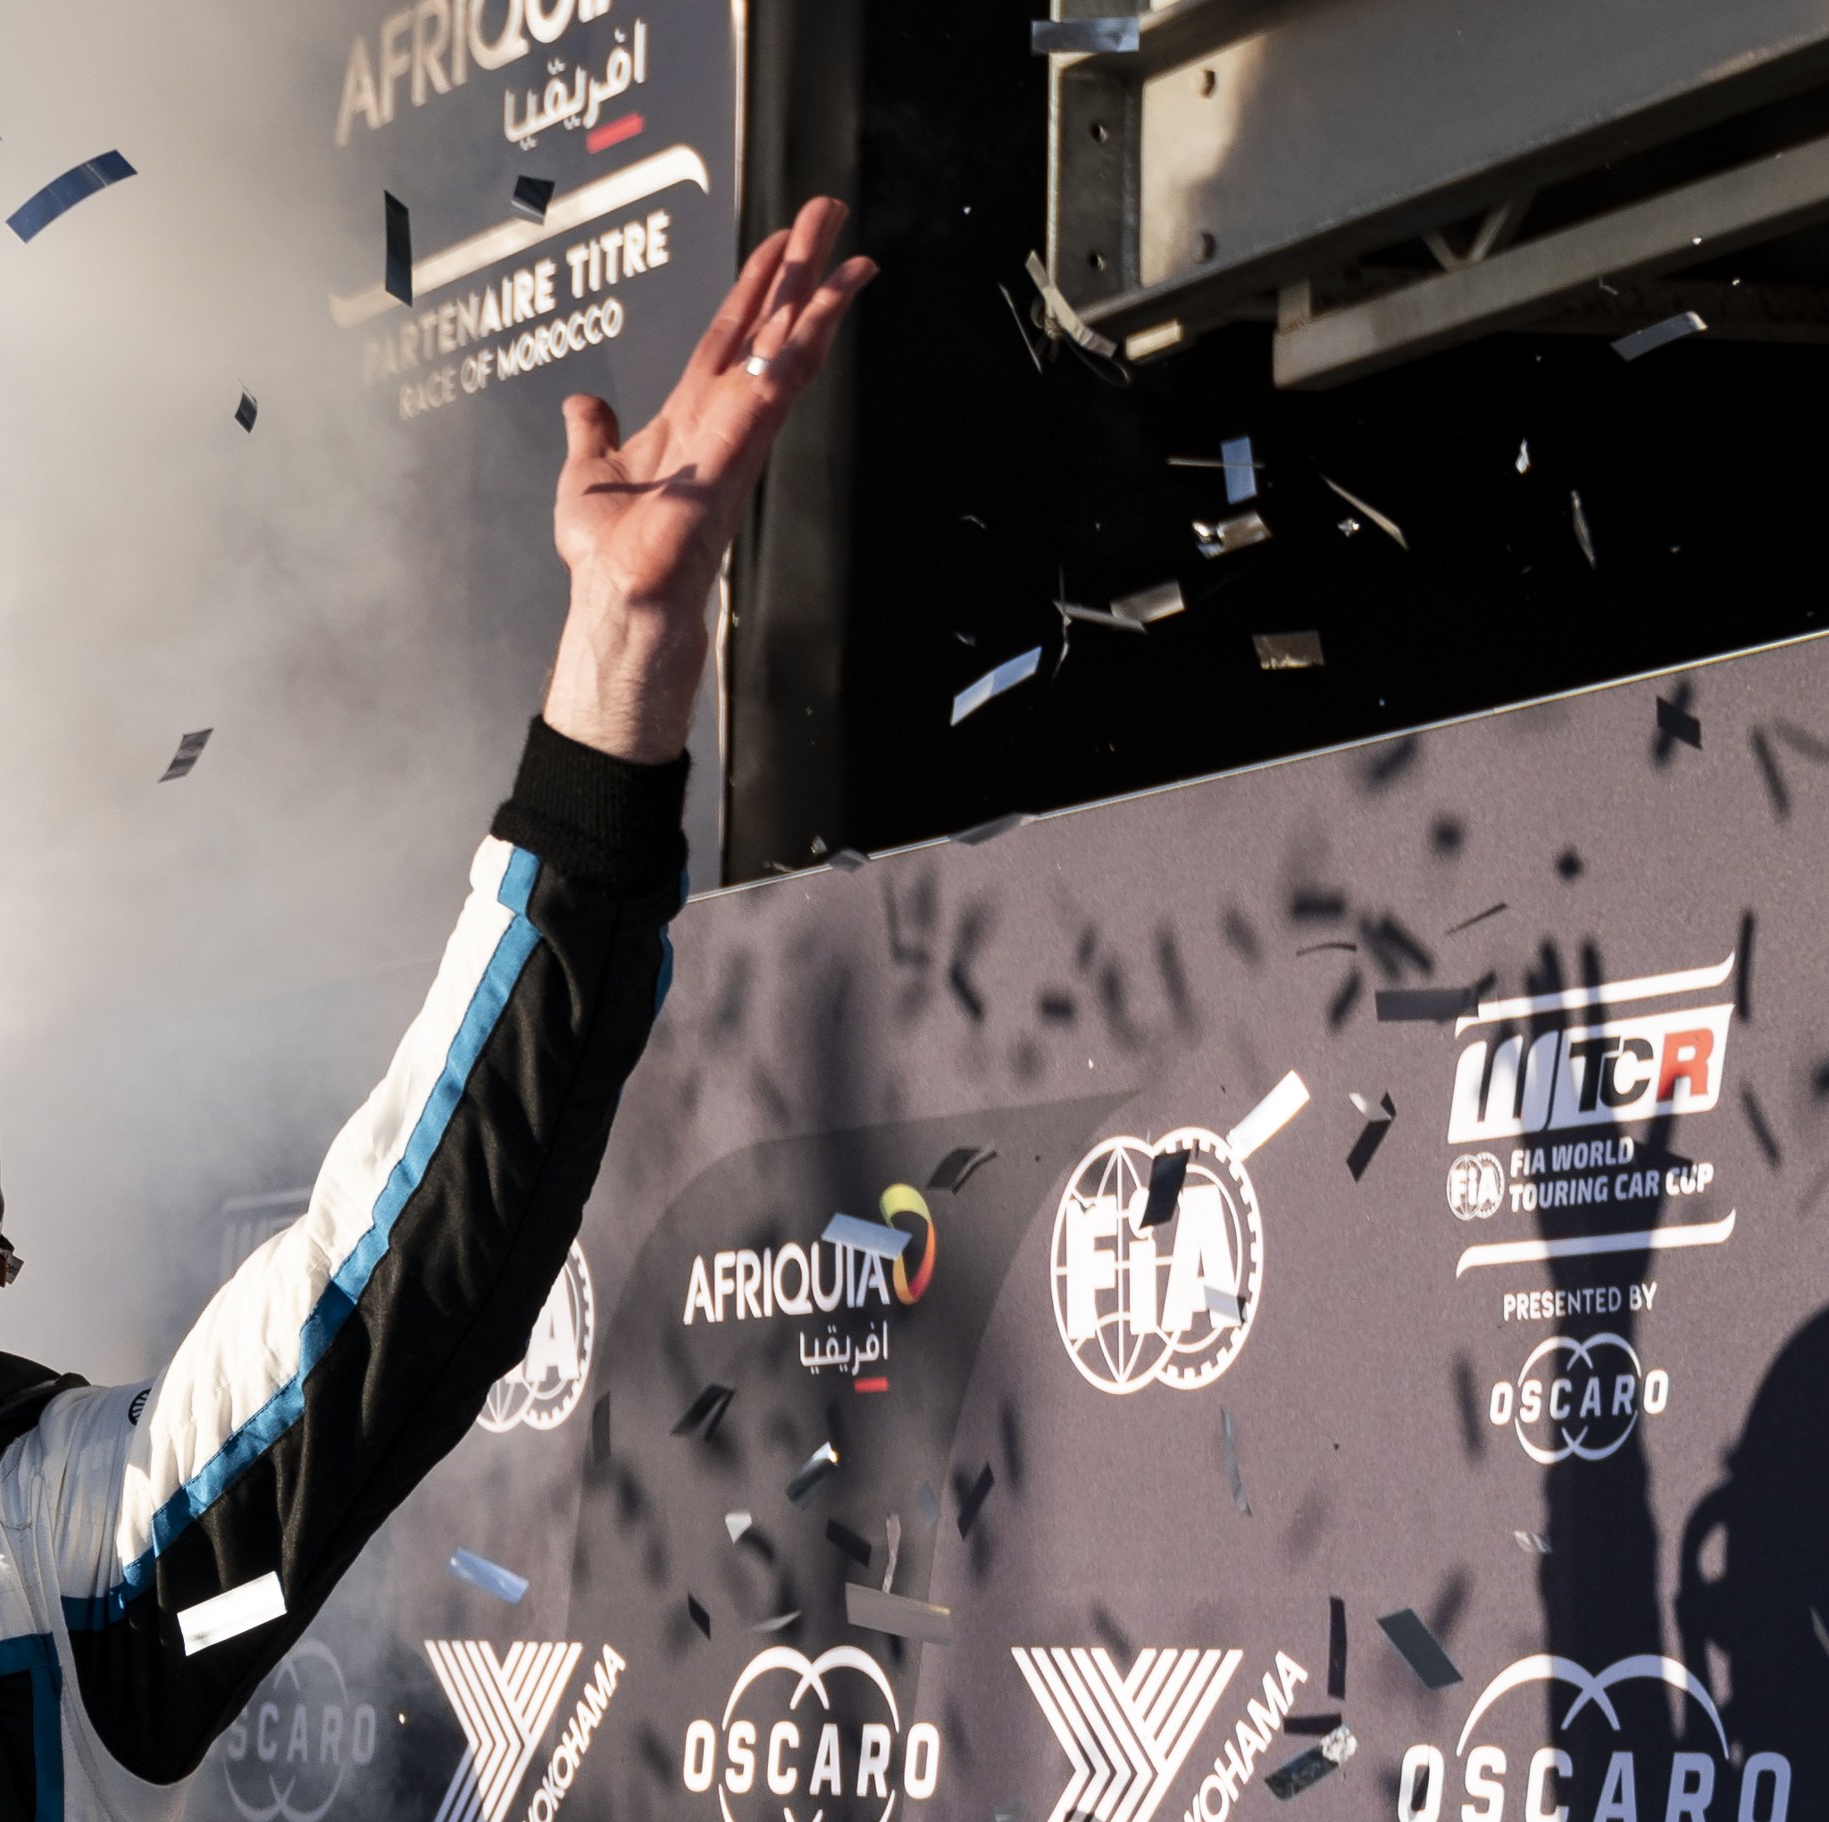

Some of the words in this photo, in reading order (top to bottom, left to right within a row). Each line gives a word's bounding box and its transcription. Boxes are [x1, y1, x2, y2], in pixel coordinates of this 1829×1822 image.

[362, 256, 556, 386] PARTENAIRE
[567, 208, 672, 299] TITRE
[460, 350, 493, 395] OF
[496, 297, 624, 382] MOROCCO
[1509, 1175, 1609, 1213] TOURING
[1614, 1169, 1661, 1204] CAR
[1665, 1161, 1714, 1196] CUP
[1510, 1147, 1546, 1178] FIA
[1552, 1135, 1635, 1173] WORLD
[683, 1236, 891, 1325] AFRIQUIA
[1503, 1286, 1622, 1322] PRESENTED
[1628, 1281, 1658, 1313] BY
[1489, 1368, 1670, 1426] OSCARO
[226, 1702, 378, 1767] SCARO
[682, 1718, 942, 1800] OSCARO
